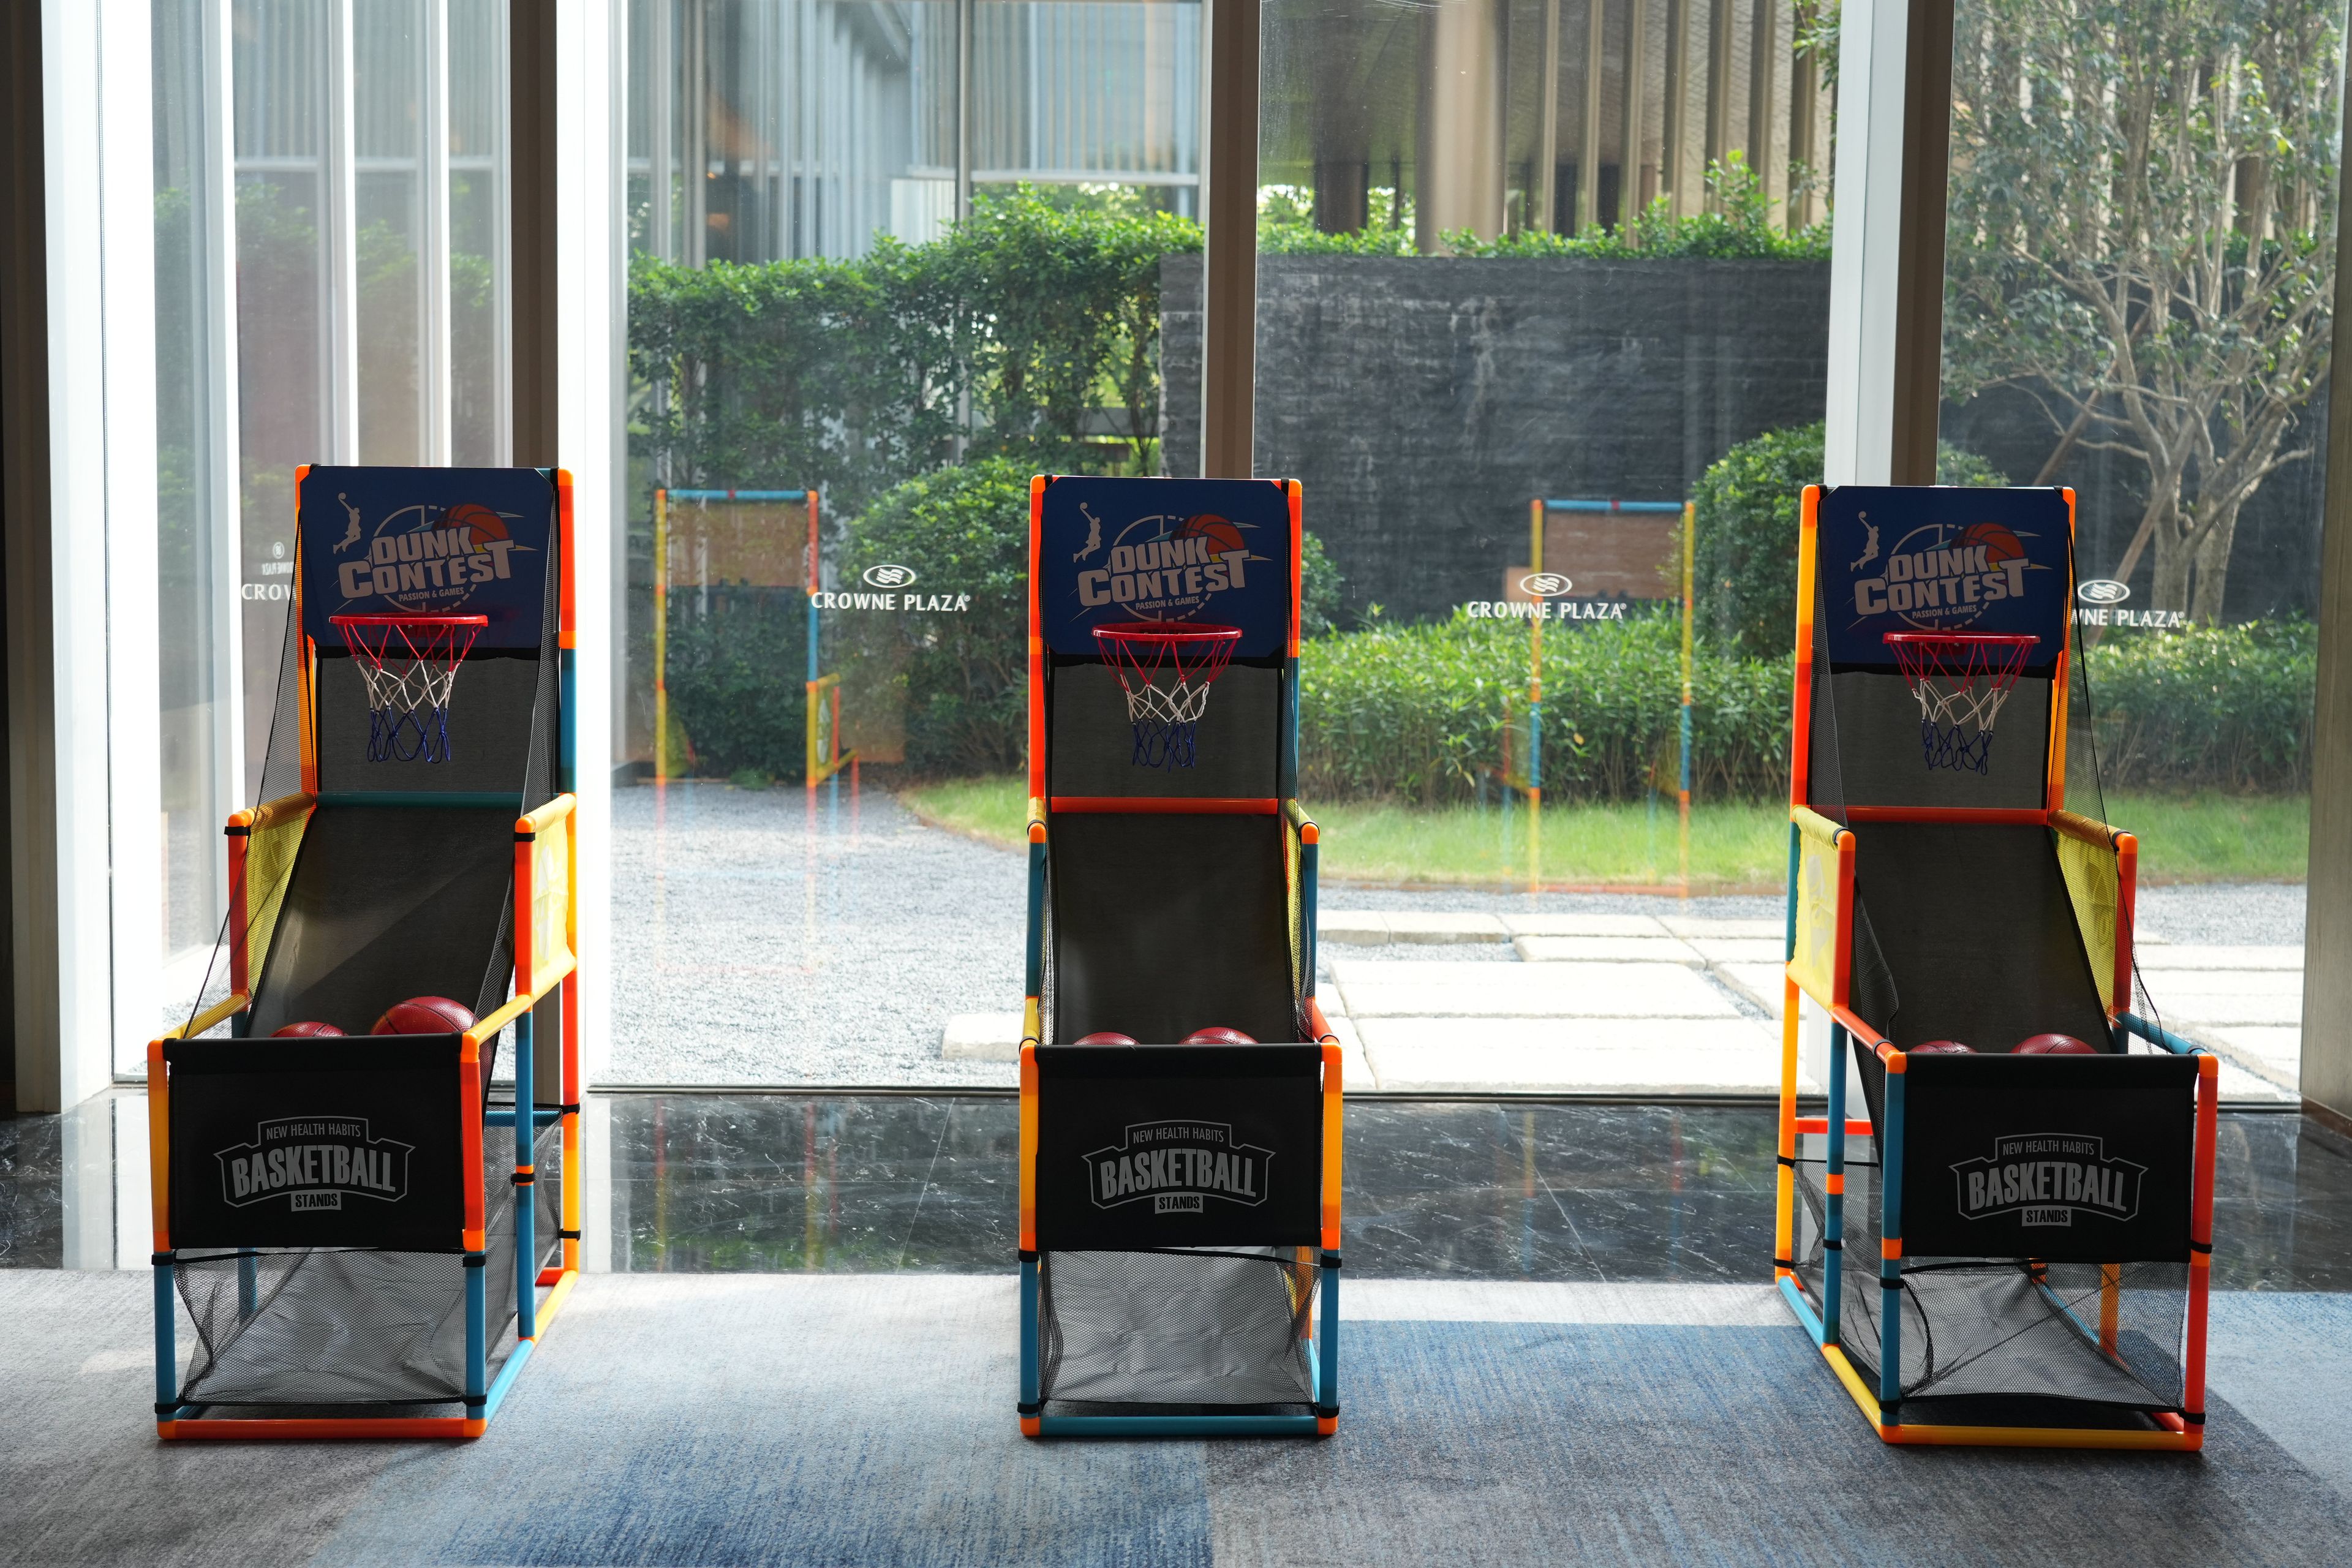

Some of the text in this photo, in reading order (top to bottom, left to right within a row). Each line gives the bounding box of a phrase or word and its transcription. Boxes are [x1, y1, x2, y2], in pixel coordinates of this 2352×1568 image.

[371, 527, 475, 565] DUNK
[1110, 536, 1210, 573] DUNK
[338, 540, 514, 598] CONTEST
[1888, 545, 1989, 582] DUNK
[1077, 549, 1250, 606] CONTEST
[399, 587, 464, 602] PASSION & GAMES
[1854, 558, 2029, 616] CONTEST
[811, 592, 896, 611] CROWNE
[1136, 599, 1166, 610] PASSION
[1175, 595, 1200, 606] GAMES
[1467, 601, 1551, 619] CROWNE
[1912, 607, 1943, 619] PASSION
[1952, 604, 1977, 614] GAMES
[266, 1123, 361, 1140] NEW HEALTH HABITS
[1133, 1126, 1224, 1144] NEW HEALTH HABITS
[2003, 1140, 2095, 1156] NEW HEALTH HABITS
[232, 1144, 396, 1198] BASKETBALL
[1100, 1148, 1256, 1200] BASKETBALL
[1968, 1161, 2127, 1212] BASKETBALL
[295, 1193, 338, 1207] STANDS
[1159, 1196, 1200, 1210] STANDS
[2026, 1210, 2068, 1223] STANDS
